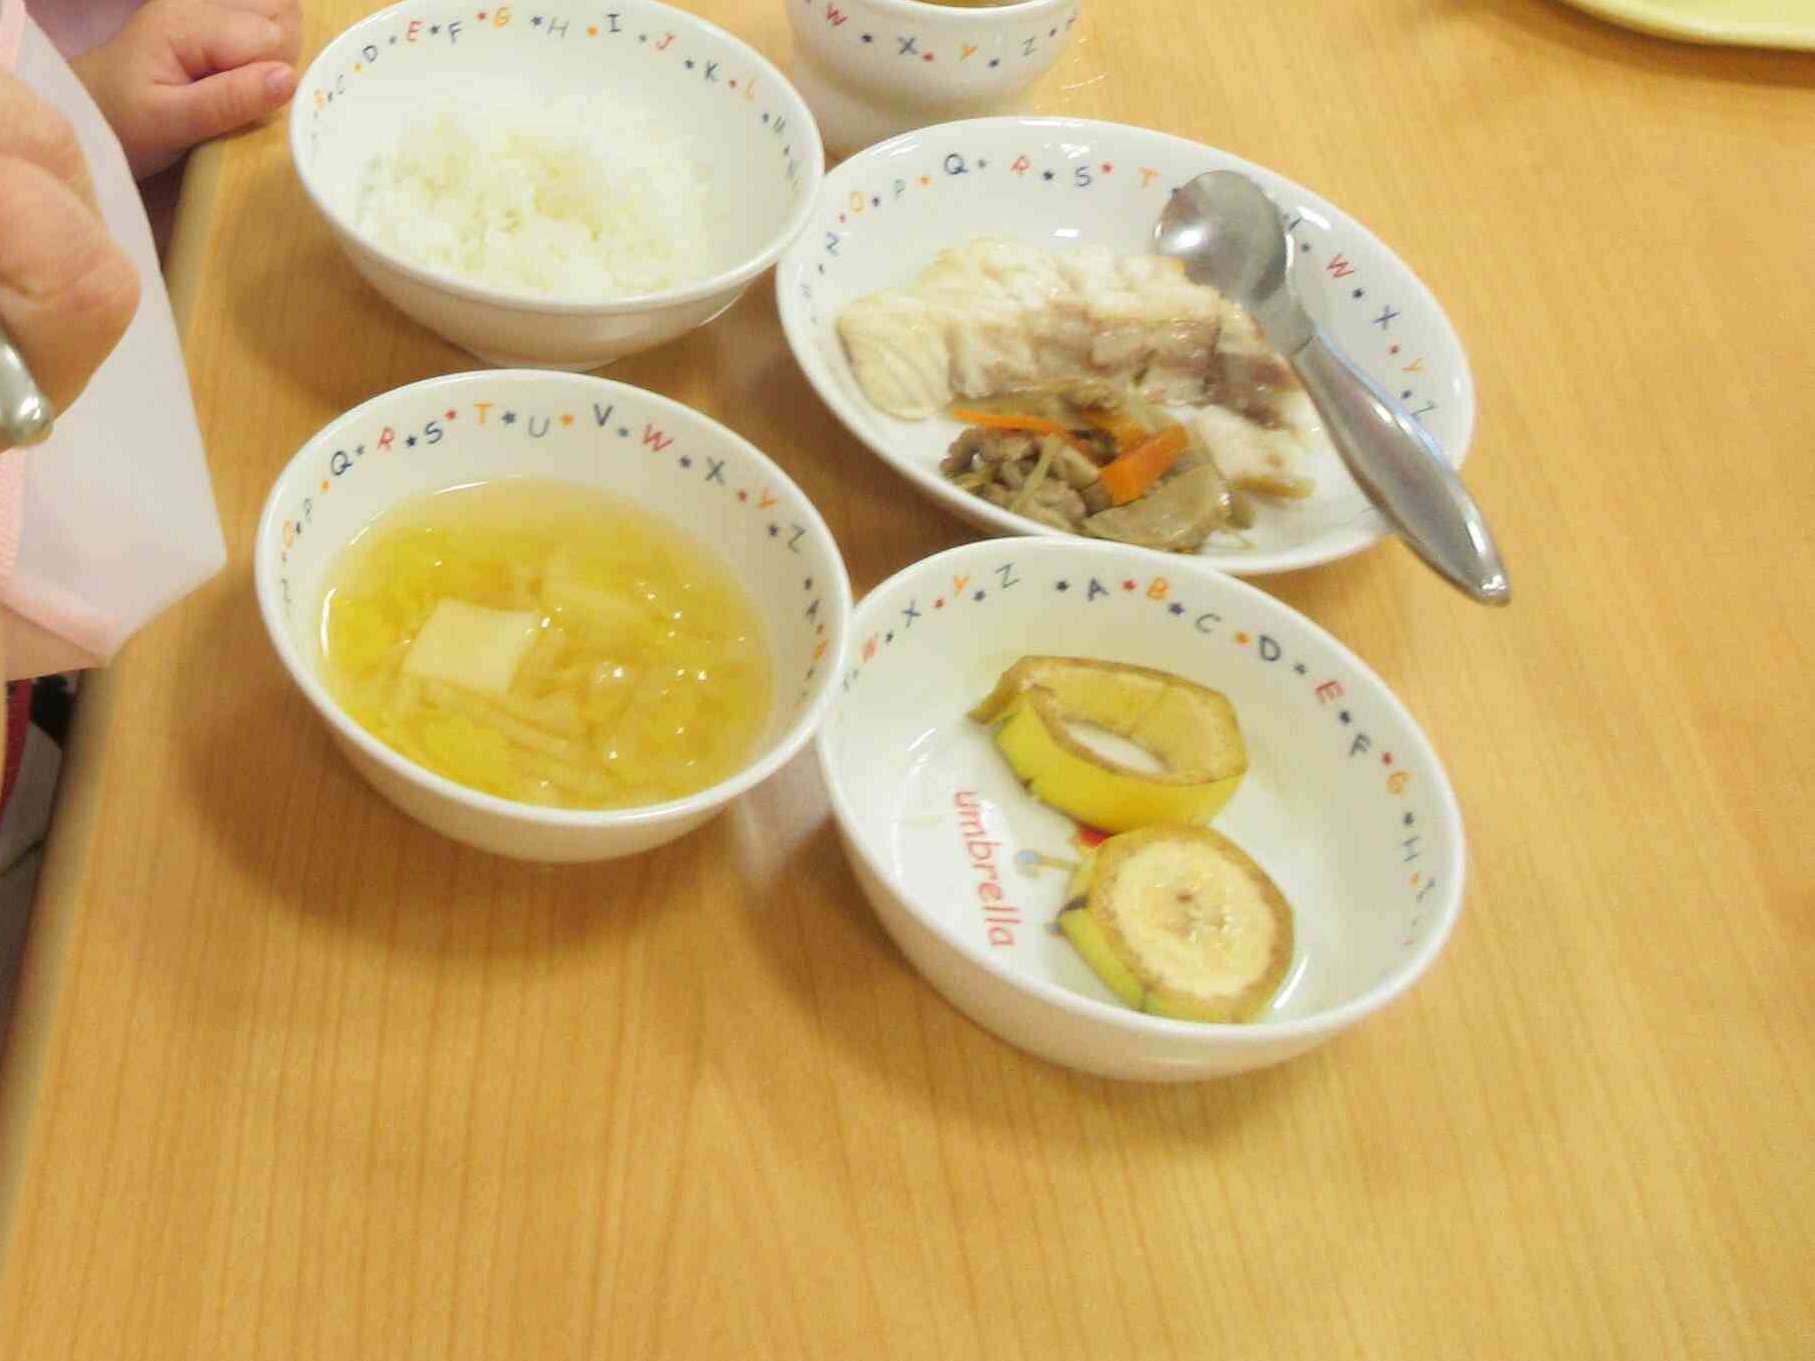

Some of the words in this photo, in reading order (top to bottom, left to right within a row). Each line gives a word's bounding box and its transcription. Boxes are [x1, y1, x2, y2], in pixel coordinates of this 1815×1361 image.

[363, 45, 379, 63] D
[407, 21, 420, 41] E
[448, 22, 461, 43] F
[493, 7, 511, 27] G
[547, 20, 569, 37] H
[608, 14, 620, 33] I
[656, 33, 675, 49] J
[704, 61, 718, 81] K
[898, 36, 917, 55] X
[944, 153, 966, 175] Q
[1011, 155, 1030, 174] R
[1075, 166, 1093, 187] S
[1138, 167, 1158, 188] T
[1326, 253, 1354, 279] W
[1373, 305, 1400, 330] X
[330, 451, 353, 475] Q
[378, 428, 395, 450] R
[424, 422, 442, 443] S
[475, 403, 493, 424] T
[528, 418, 550, 437] U
[592, 404, 612, 426] V
[642, 424, 672, 452] W
[705, 458, 725, 484] X
[787, 524, 805, 553] Z
[953, 575, 970, 594] Y
[996, 564, 1020, 588] Z
[1087, 579, 1108, 600] A
[1147, 578, 1168, 600] B
[1196, 613, 1220, 633] C
[1259, 637, 1280, 662] D
[1315, 680, 1343, 703] E
[1349, 733, 1370, 756] F
[953, 791, 1021, 947] umbrella
